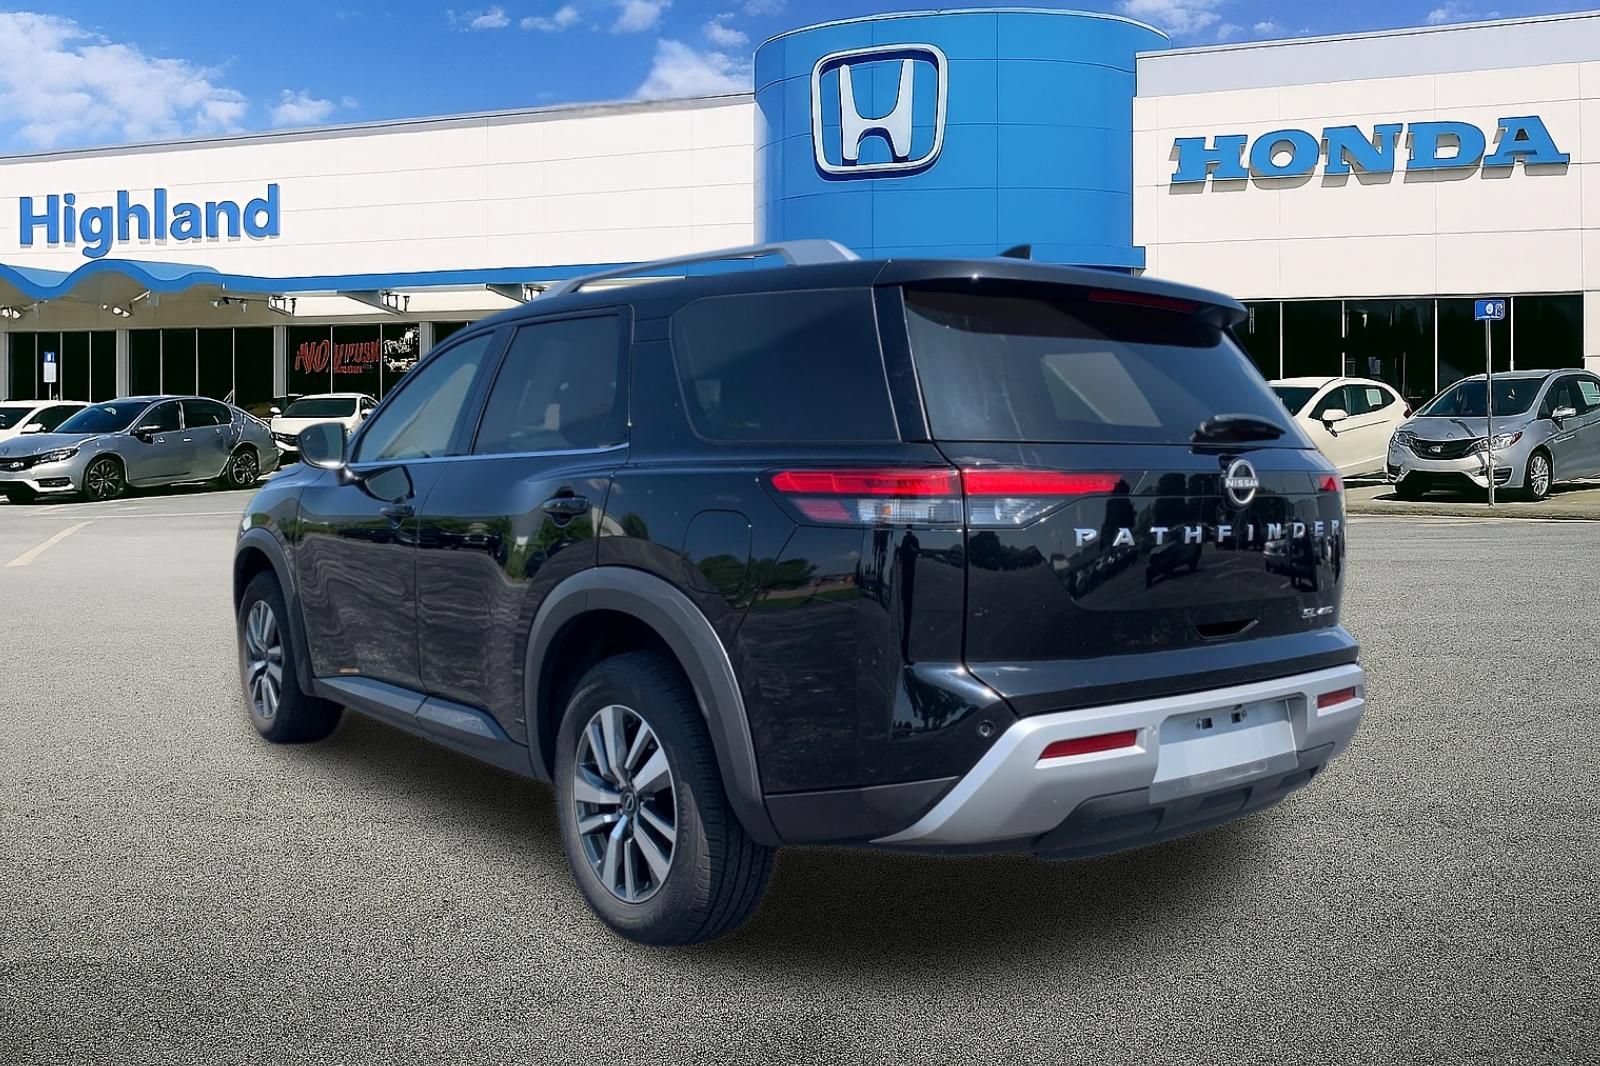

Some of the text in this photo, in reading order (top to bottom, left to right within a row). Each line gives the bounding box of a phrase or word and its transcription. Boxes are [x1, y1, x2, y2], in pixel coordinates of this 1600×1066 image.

[1170, 115, 1570, 185] HONDA
[19, 183, 281, 258] Highland
[1225, 477, 1259, 489] NISSAN
[1074, 519, 1340, 547] PATHFINDER
